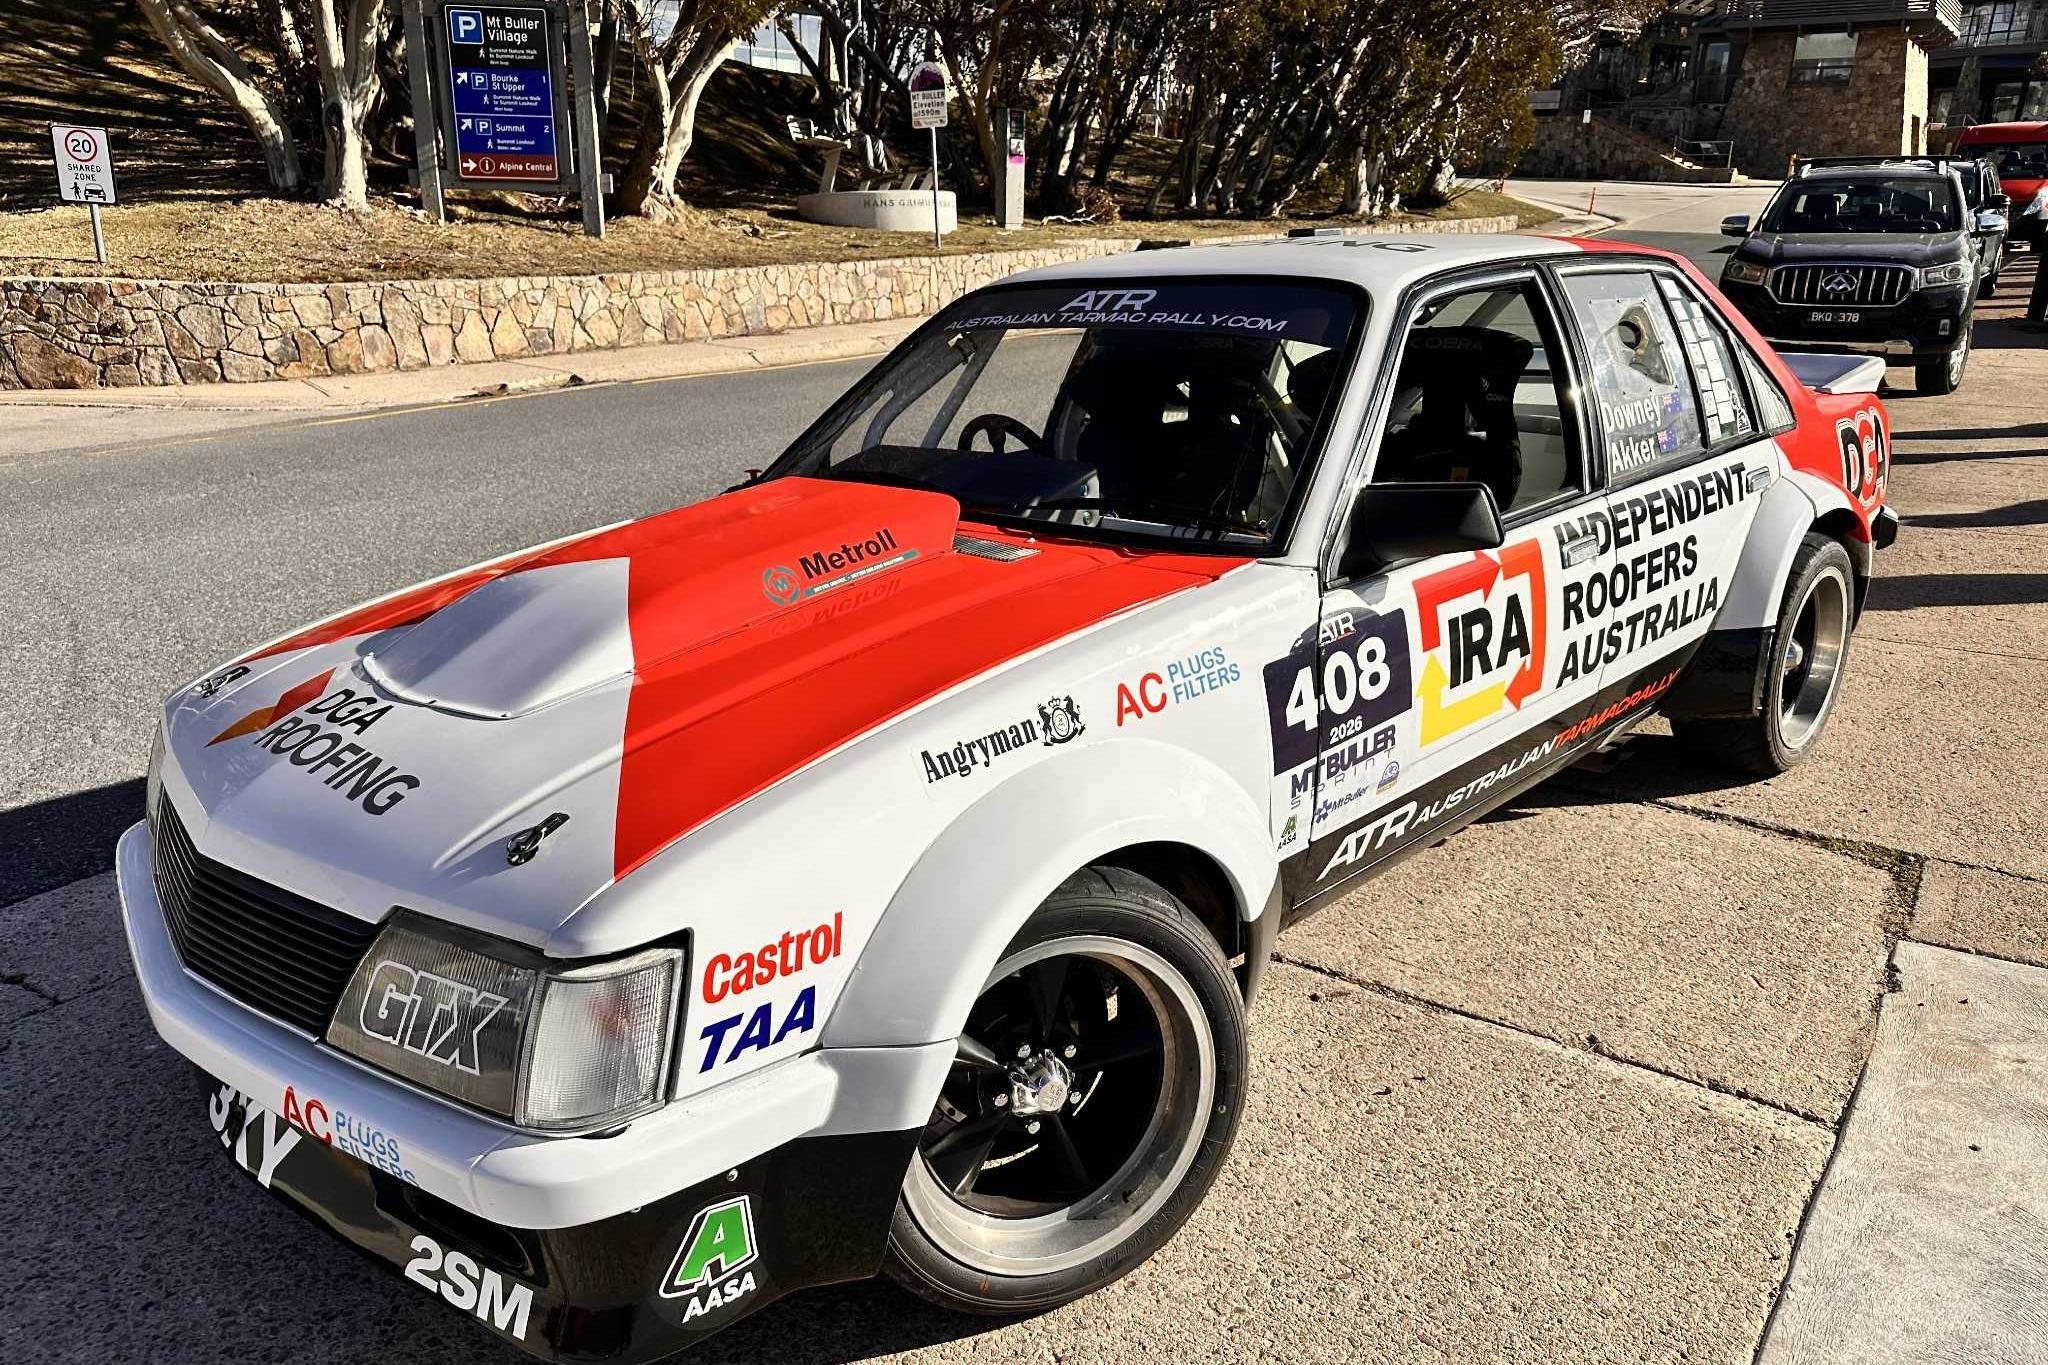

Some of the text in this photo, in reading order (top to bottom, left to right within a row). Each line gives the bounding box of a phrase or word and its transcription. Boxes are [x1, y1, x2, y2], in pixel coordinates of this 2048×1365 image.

[458, 15, 476, 38] P
[486, 15, 540, 30] Mt Buller
[487, 29, 528, 45] Village
[474, 75, 485, 87] P
[491, 73, 519, 83] Bourke
[492, 82, 525, 92] St Upper
[70, 138, 92, 153] 20
[479, 121, 550, 133] P Summit 2
[67, 163, 102, 173] SHARED
[74, 172, 97, 181] ZONE
[499, 162, 524, 172] Alpine
[525, 162, 552, 172] Central
[863, 199, 895, 208] HANS
[1059, 289, 1158, 312] ATR
[944, 311, 1288, 333] AUSTRALIAN TARMAC RALLY.COM
[1600, 393, 1662, 434] Downey
[1611, 434, 1658, 474] Akker
[798, 528, 898, 579] Metroll
[1563, 534, 1698, 632] ROOFERS
[1447, 592, 1531, 690] IRA
[1555, 576, 1719, 690] AUSTRALIA
[1115, 646, 1226, 727] AC PLUGS
[1172, 663, 1241, 704] FILTERS
[1285, 636, 1391, 732] 408
[304, 688, 394, 736] DGA
[1329, 715, 1363, 745] 2026
[254, 716, 421, 816] ROOFING
[920, 718, 1039, 784] Angryman
[1326, 723, 1396, 780] BULLER
[1277, 832, 1297, 852] AASA
[1316, 800, 1418, 882] ATR
[702, 911, 843, 1004] Castrol
[360, 960, 510, 1076] GTX
[699, 984, 816, 1075] TAA
[284, 1085, 400, 1163] AC PLUGS
[404, 1234, 535, 1342] 2SM
[681, 1271, 757, 1324] AASA
